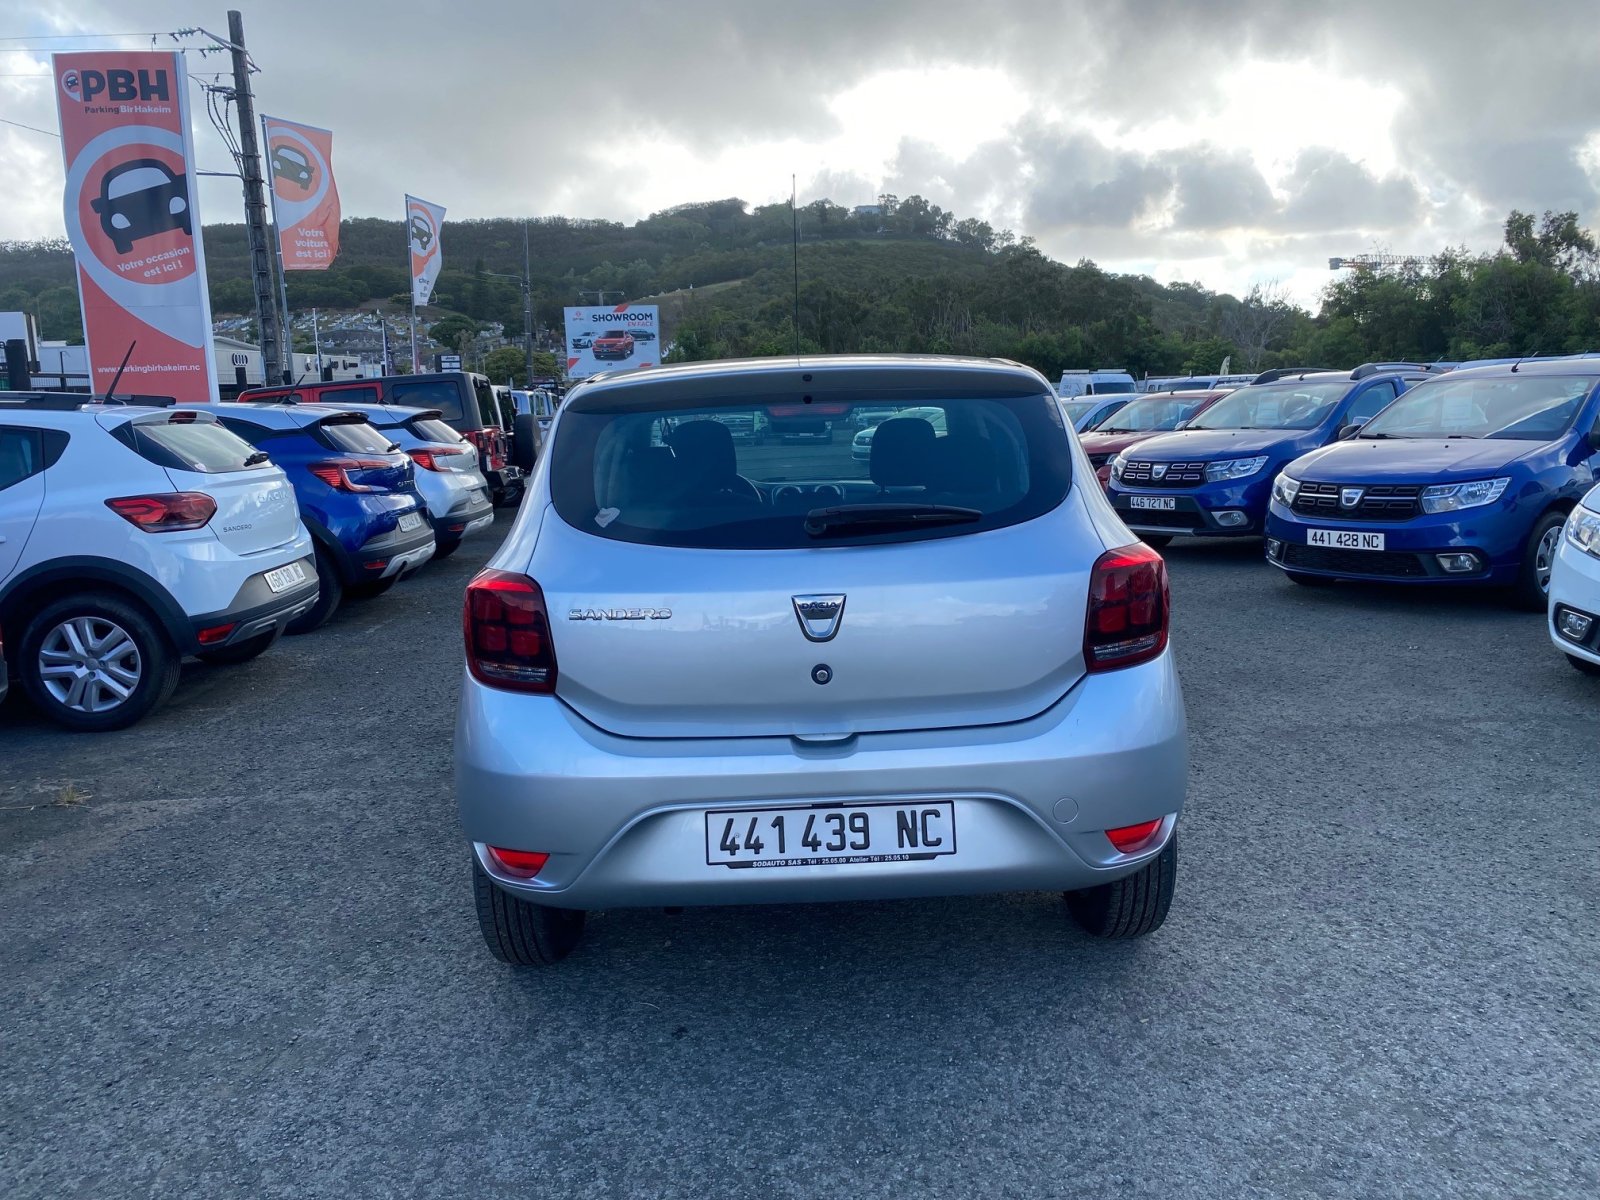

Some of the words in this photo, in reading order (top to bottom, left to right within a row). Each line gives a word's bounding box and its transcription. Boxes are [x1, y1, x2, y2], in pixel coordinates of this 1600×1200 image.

[81, 69, 170, 102] PBH
[297, 227, 325, 238] Votre
[295, 239, 329, 248] voiture
[117, 260, 144, 272] Votre
[145, 246, 190, 264] occasion
[295, 249, 312, 258] est
[143, 266, 161, 278] est
[162, 261, 177, 273] ici
[591, 312, 653, 322] SHOWROOM
[97, 363, 200, 374] www.arkingbirhakeim.nc
[1131, 498, 1145, 508] 446
[1147, 498, 1162, 509] 727
[1163, 498, 1174, 509] NC
[223, 523, 253, 533] SANDERO
[1311, 531, 1331, 545] 441
[1336, 533, 1359, 547] 428
[1362, 534, 1379, 548] NC
[801, 601, 839, 609] DACIA
[568, 608, 673, 621] SANDERO
[719, 815, 786, 856] 441
[801, 812, 870, 852] 439
[896, 809, 942, 849] NC
[752, 860, 786, 868] SODAUTO
